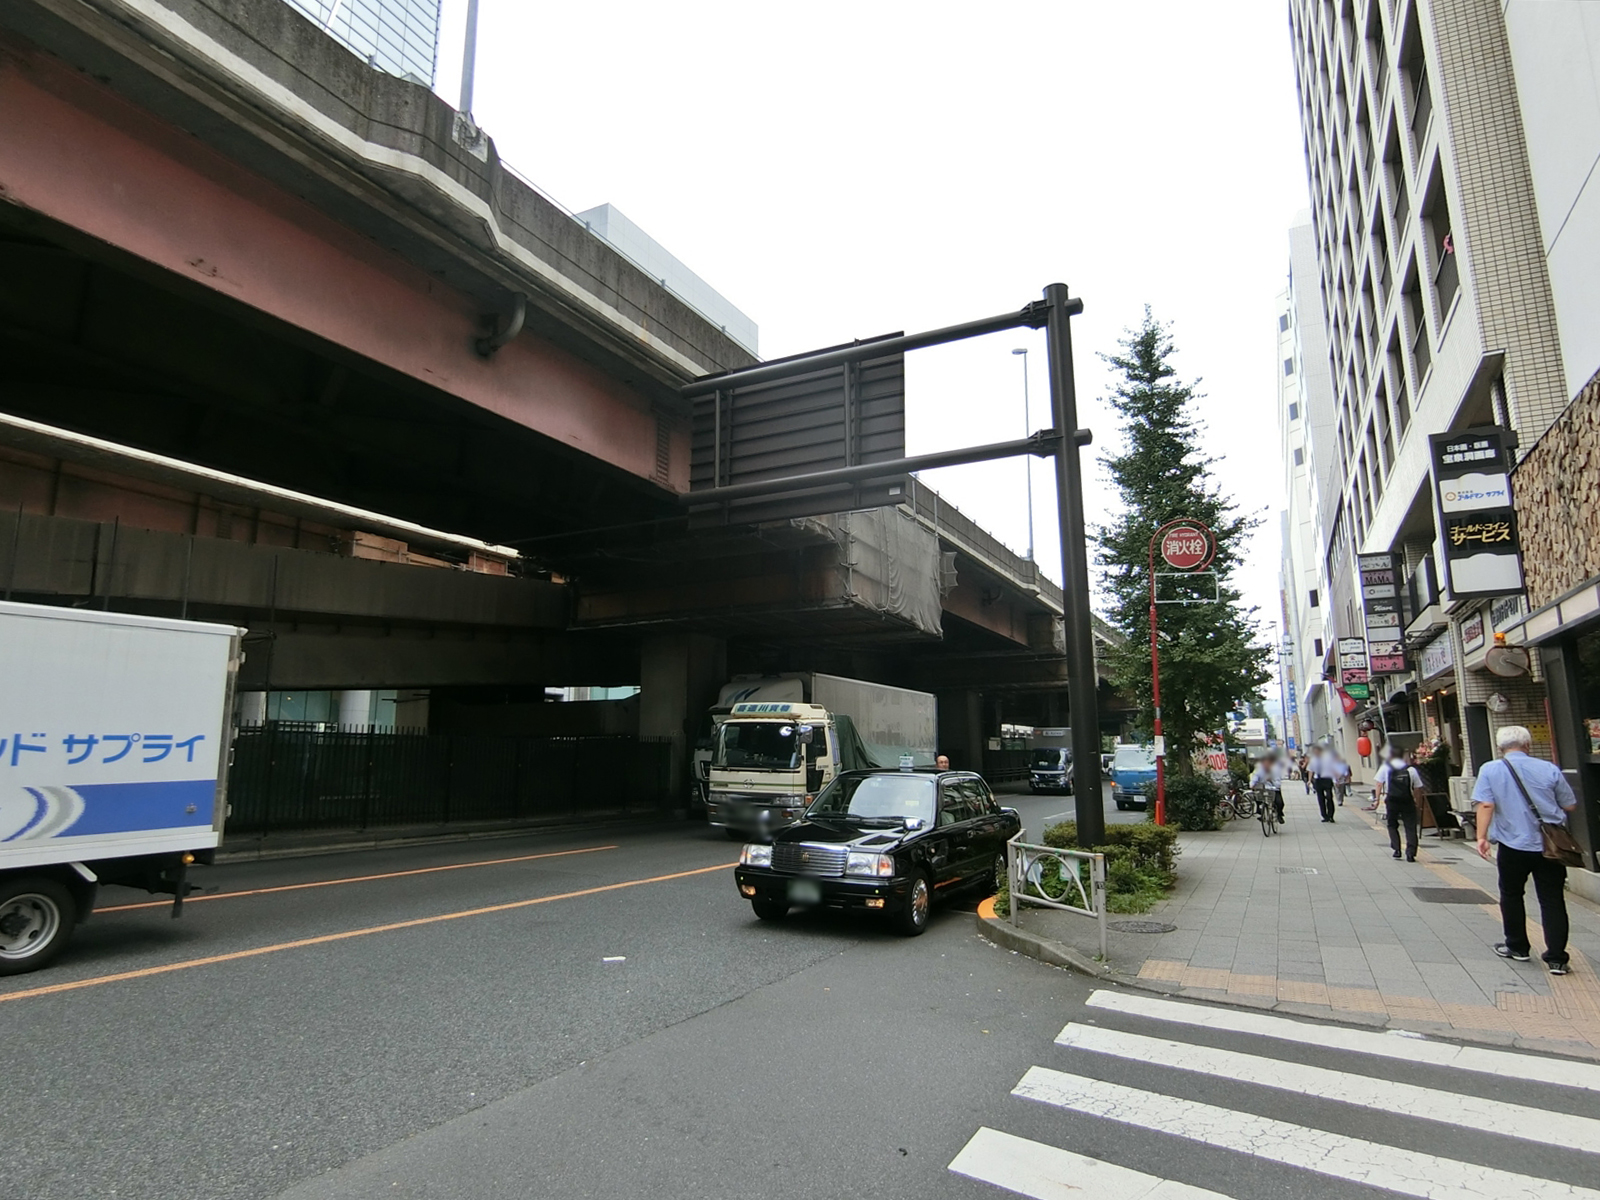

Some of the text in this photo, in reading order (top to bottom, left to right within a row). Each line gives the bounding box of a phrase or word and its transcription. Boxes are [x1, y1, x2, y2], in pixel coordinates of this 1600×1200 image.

[1451, 529, 1511, 546] サービス
[1166, 539, 1203, 556] 消火栓
[0, 732, 206, 766] ド サプライ
